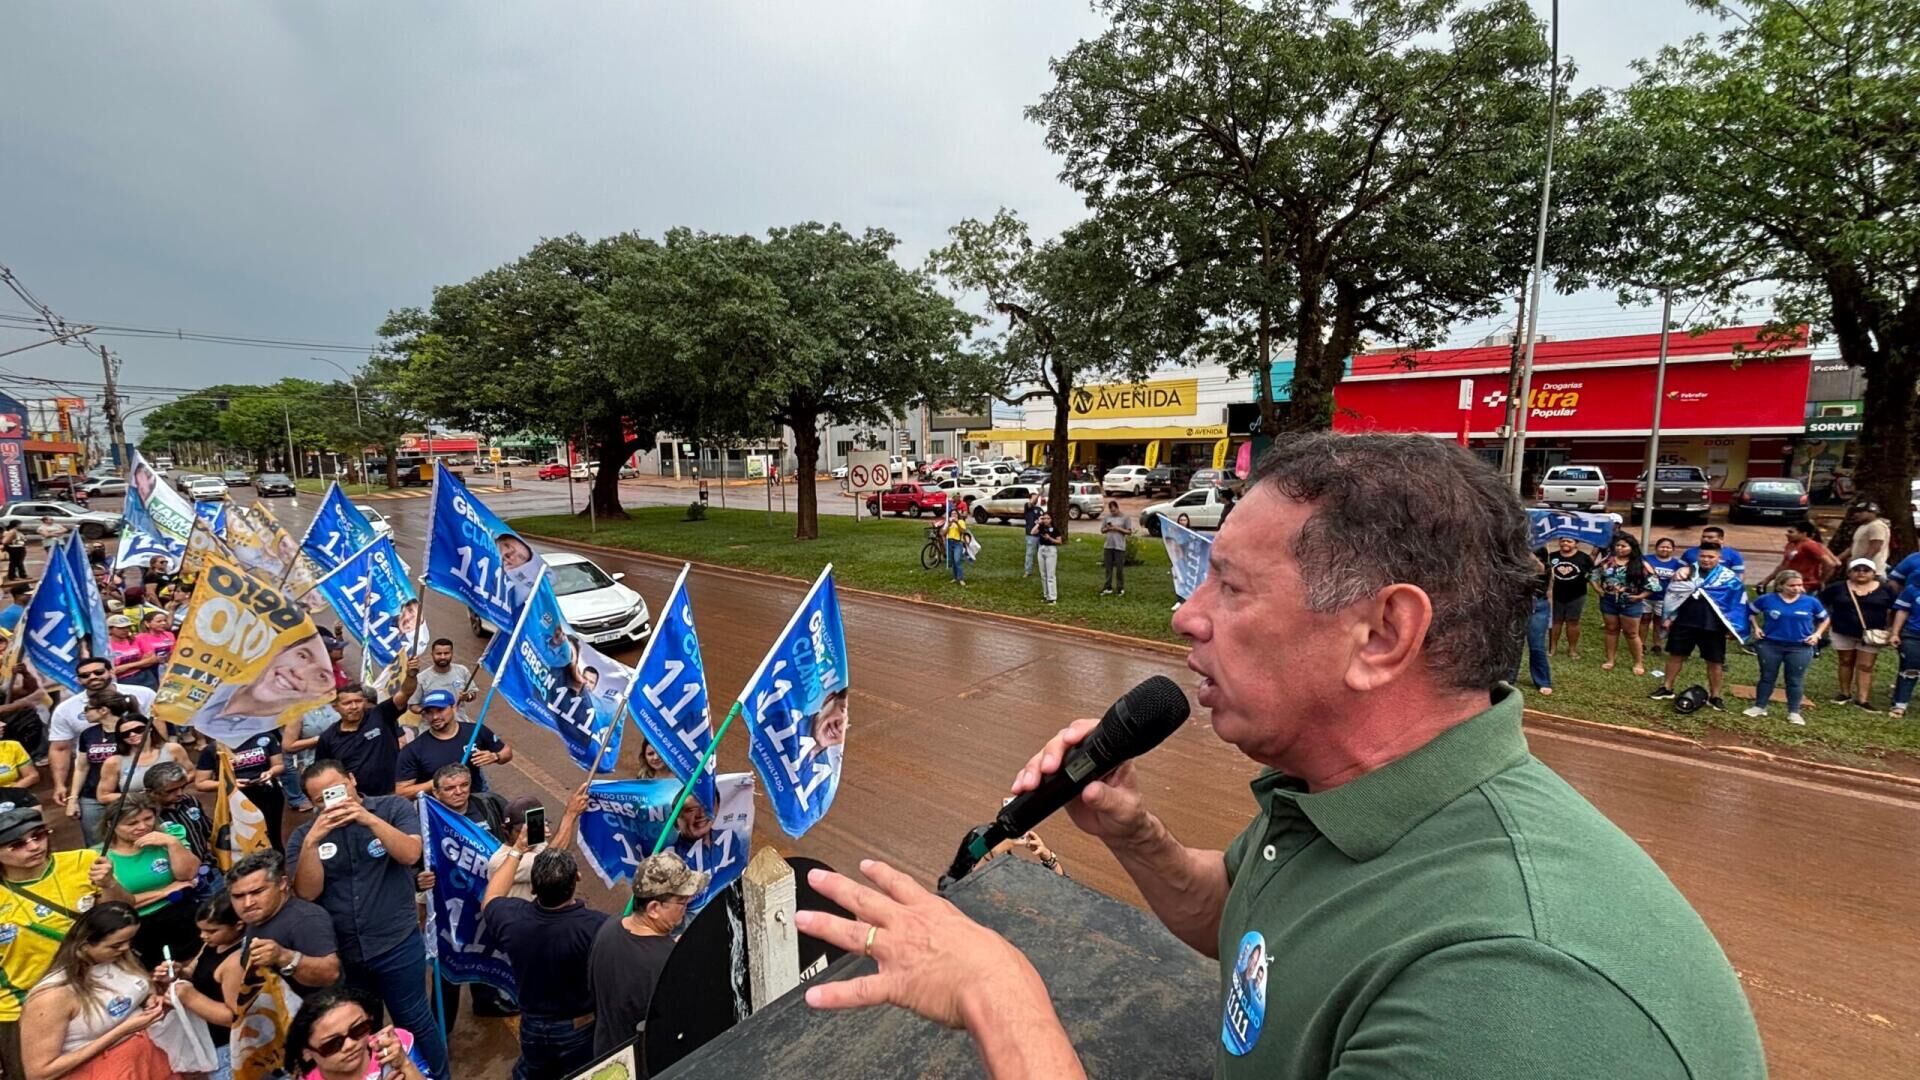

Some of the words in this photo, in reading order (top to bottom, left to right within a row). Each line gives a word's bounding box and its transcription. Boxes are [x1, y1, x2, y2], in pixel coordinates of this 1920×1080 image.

[1814, 364, 1849, 373] Picolés
[1096, 388, 1182, 410] AVENIDA
[1517, 388, 1579, 409] ltra
[1542, 382, 1583, 391] Drogarias
[1531, 407, 1577, 419] Popular
[1194, 428, 1223, 436] AVENIDA
[8, 464, 23, 496] DROGARIA
[149, 509, 190, 538] VERRUC
[520, 640, 556, 690] GERSON
[89, 746, 117, 754] GERSO
[676, 752, 704, 785] RESULTAO
[760, 750, 785, 793] RESULTADO
[585, 797, 665, 822] GERSON
[443, 824, 485, 853] DEPUTADO
[440, 836, 490, 880] GER
[1241, 994, 1260, 1029] CLARO
